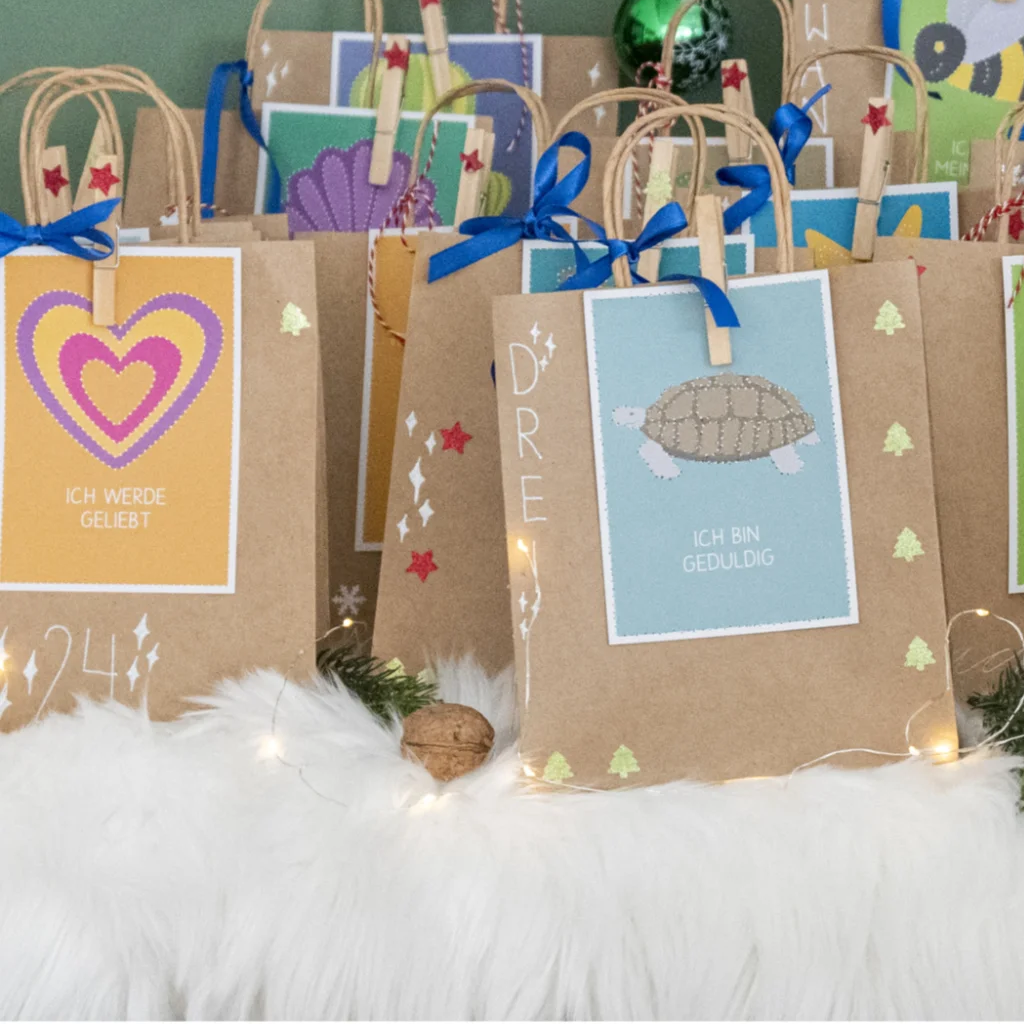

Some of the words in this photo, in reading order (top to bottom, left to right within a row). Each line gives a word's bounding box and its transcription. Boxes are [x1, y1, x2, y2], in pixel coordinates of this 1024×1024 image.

[951, 139, 967, 156] IC
[65, 487, 96, 505] ICH
[103, 487, 167, 505] WERDE
[80, 511, 151, 529] GELIEBT
[693, 528, 724, 547] ICH
[731, 526, 760, 545] BIN
[682, 548, 775, 573] GEDULDIG
